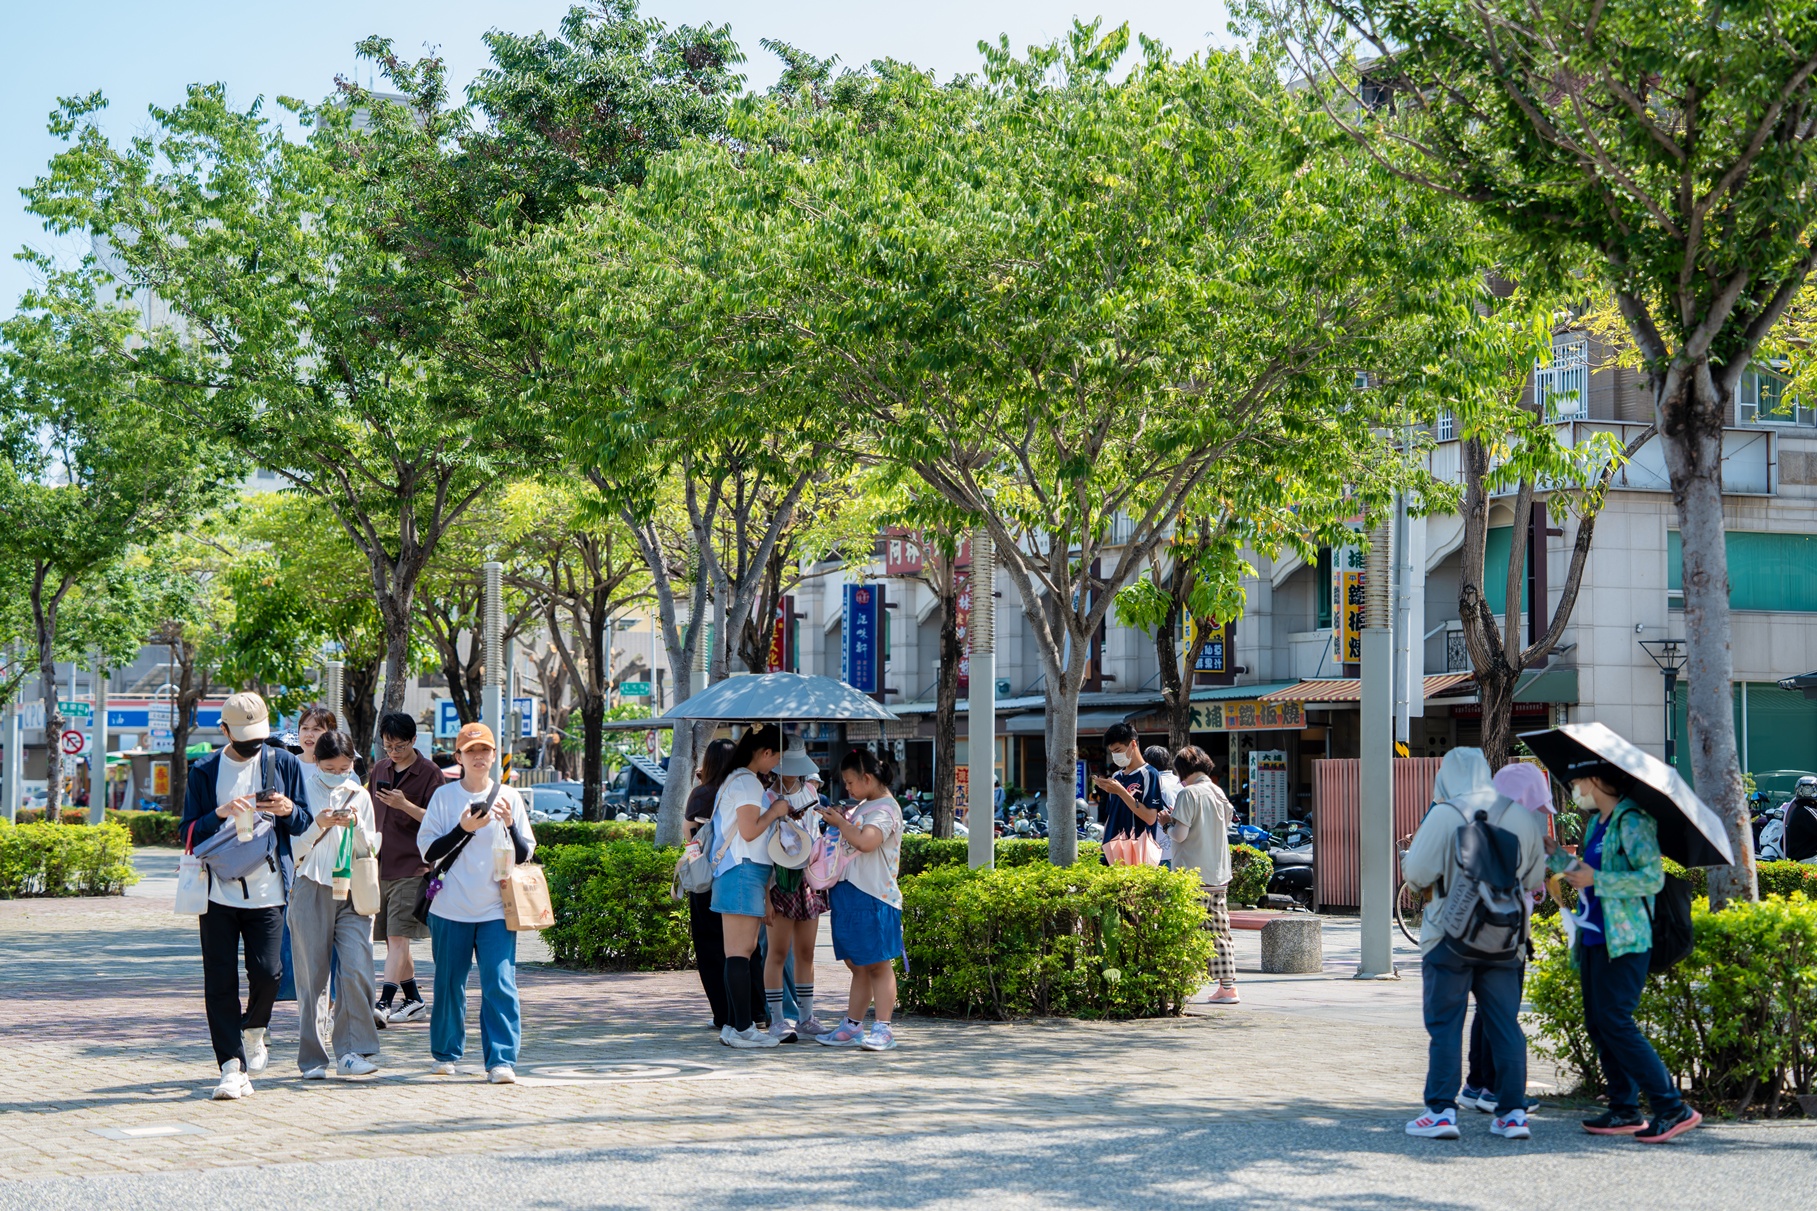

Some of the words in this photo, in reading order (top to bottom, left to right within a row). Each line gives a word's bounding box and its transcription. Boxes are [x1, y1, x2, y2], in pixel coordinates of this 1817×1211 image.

[1200, 644, 1222, 656] 仙草
[24, 705, 42, 729] CPC
[442, 703, 459, 734] P
